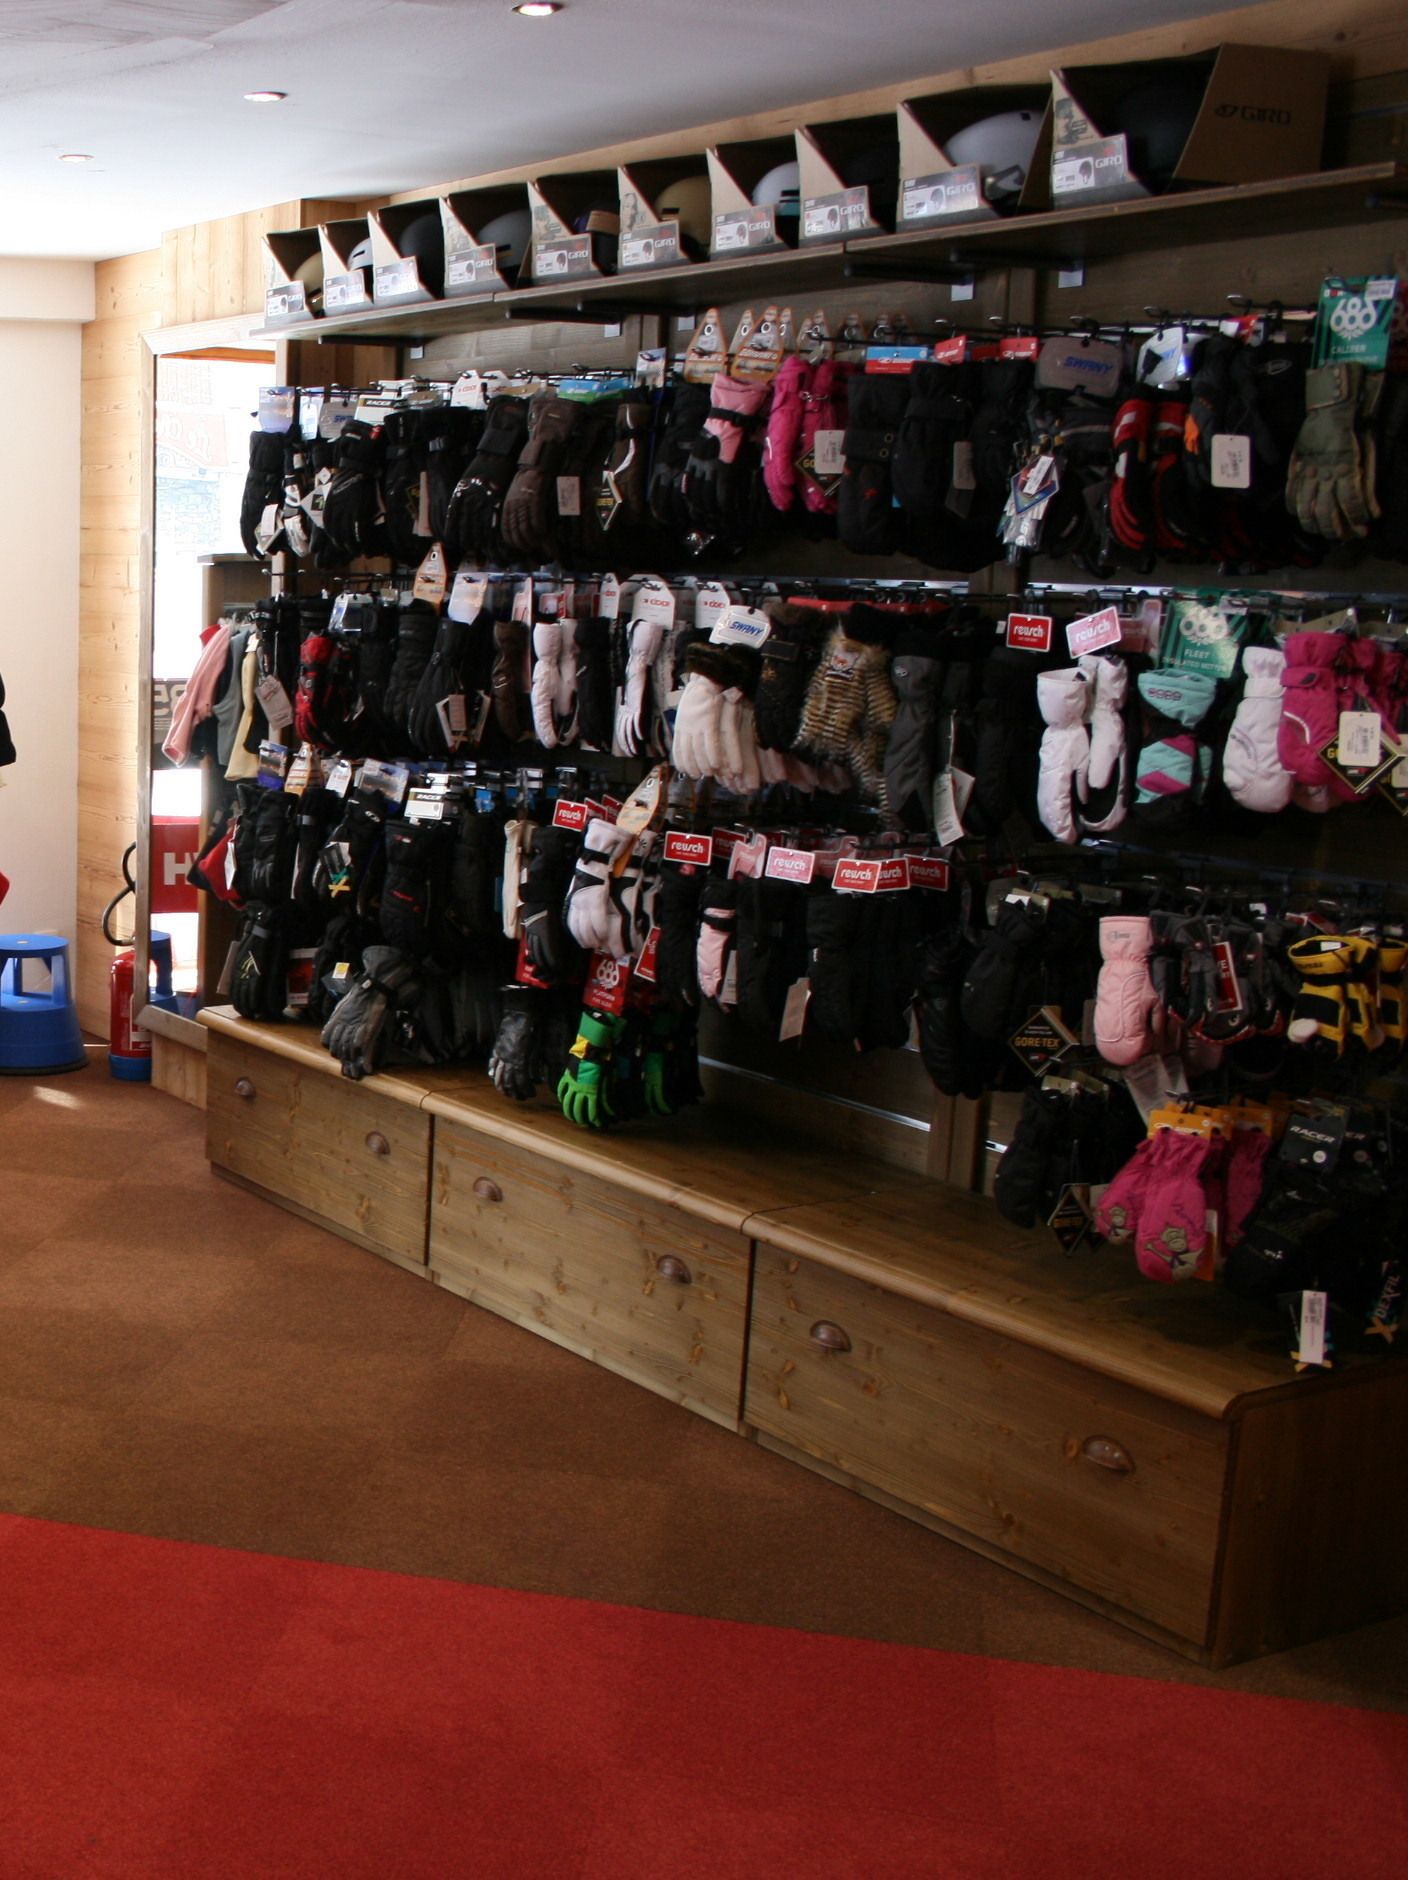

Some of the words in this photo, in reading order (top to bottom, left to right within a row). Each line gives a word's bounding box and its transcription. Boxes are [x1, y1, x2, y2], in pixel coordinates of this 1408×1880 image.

[1241, 105, 1292, 126] GIRO
[1094, 153, 1123, 169] GIRO
[946, 181, 976, 197] GIRO
[840, 203, 864, 216] GIRO
[748, 219, 771, 232] GIRO
[654, 237, 675, 249] GIRO
[567, 249, 589, 261] GIRO
[1063, 355, 1113, 375] SWANY
[729, 620, 765, 637] SWANY
[1012, 624, 1045, 639] reusch
[1075, 620, 1112, 644] reusch
[558, 808, 582, 821] reusch
[671, 841, 705, 854] reusch
[773, 856, 806, 871] reusch
[840, 868, 873, 881] reusch
[1290, 1125, 1336, 1143] RACER
